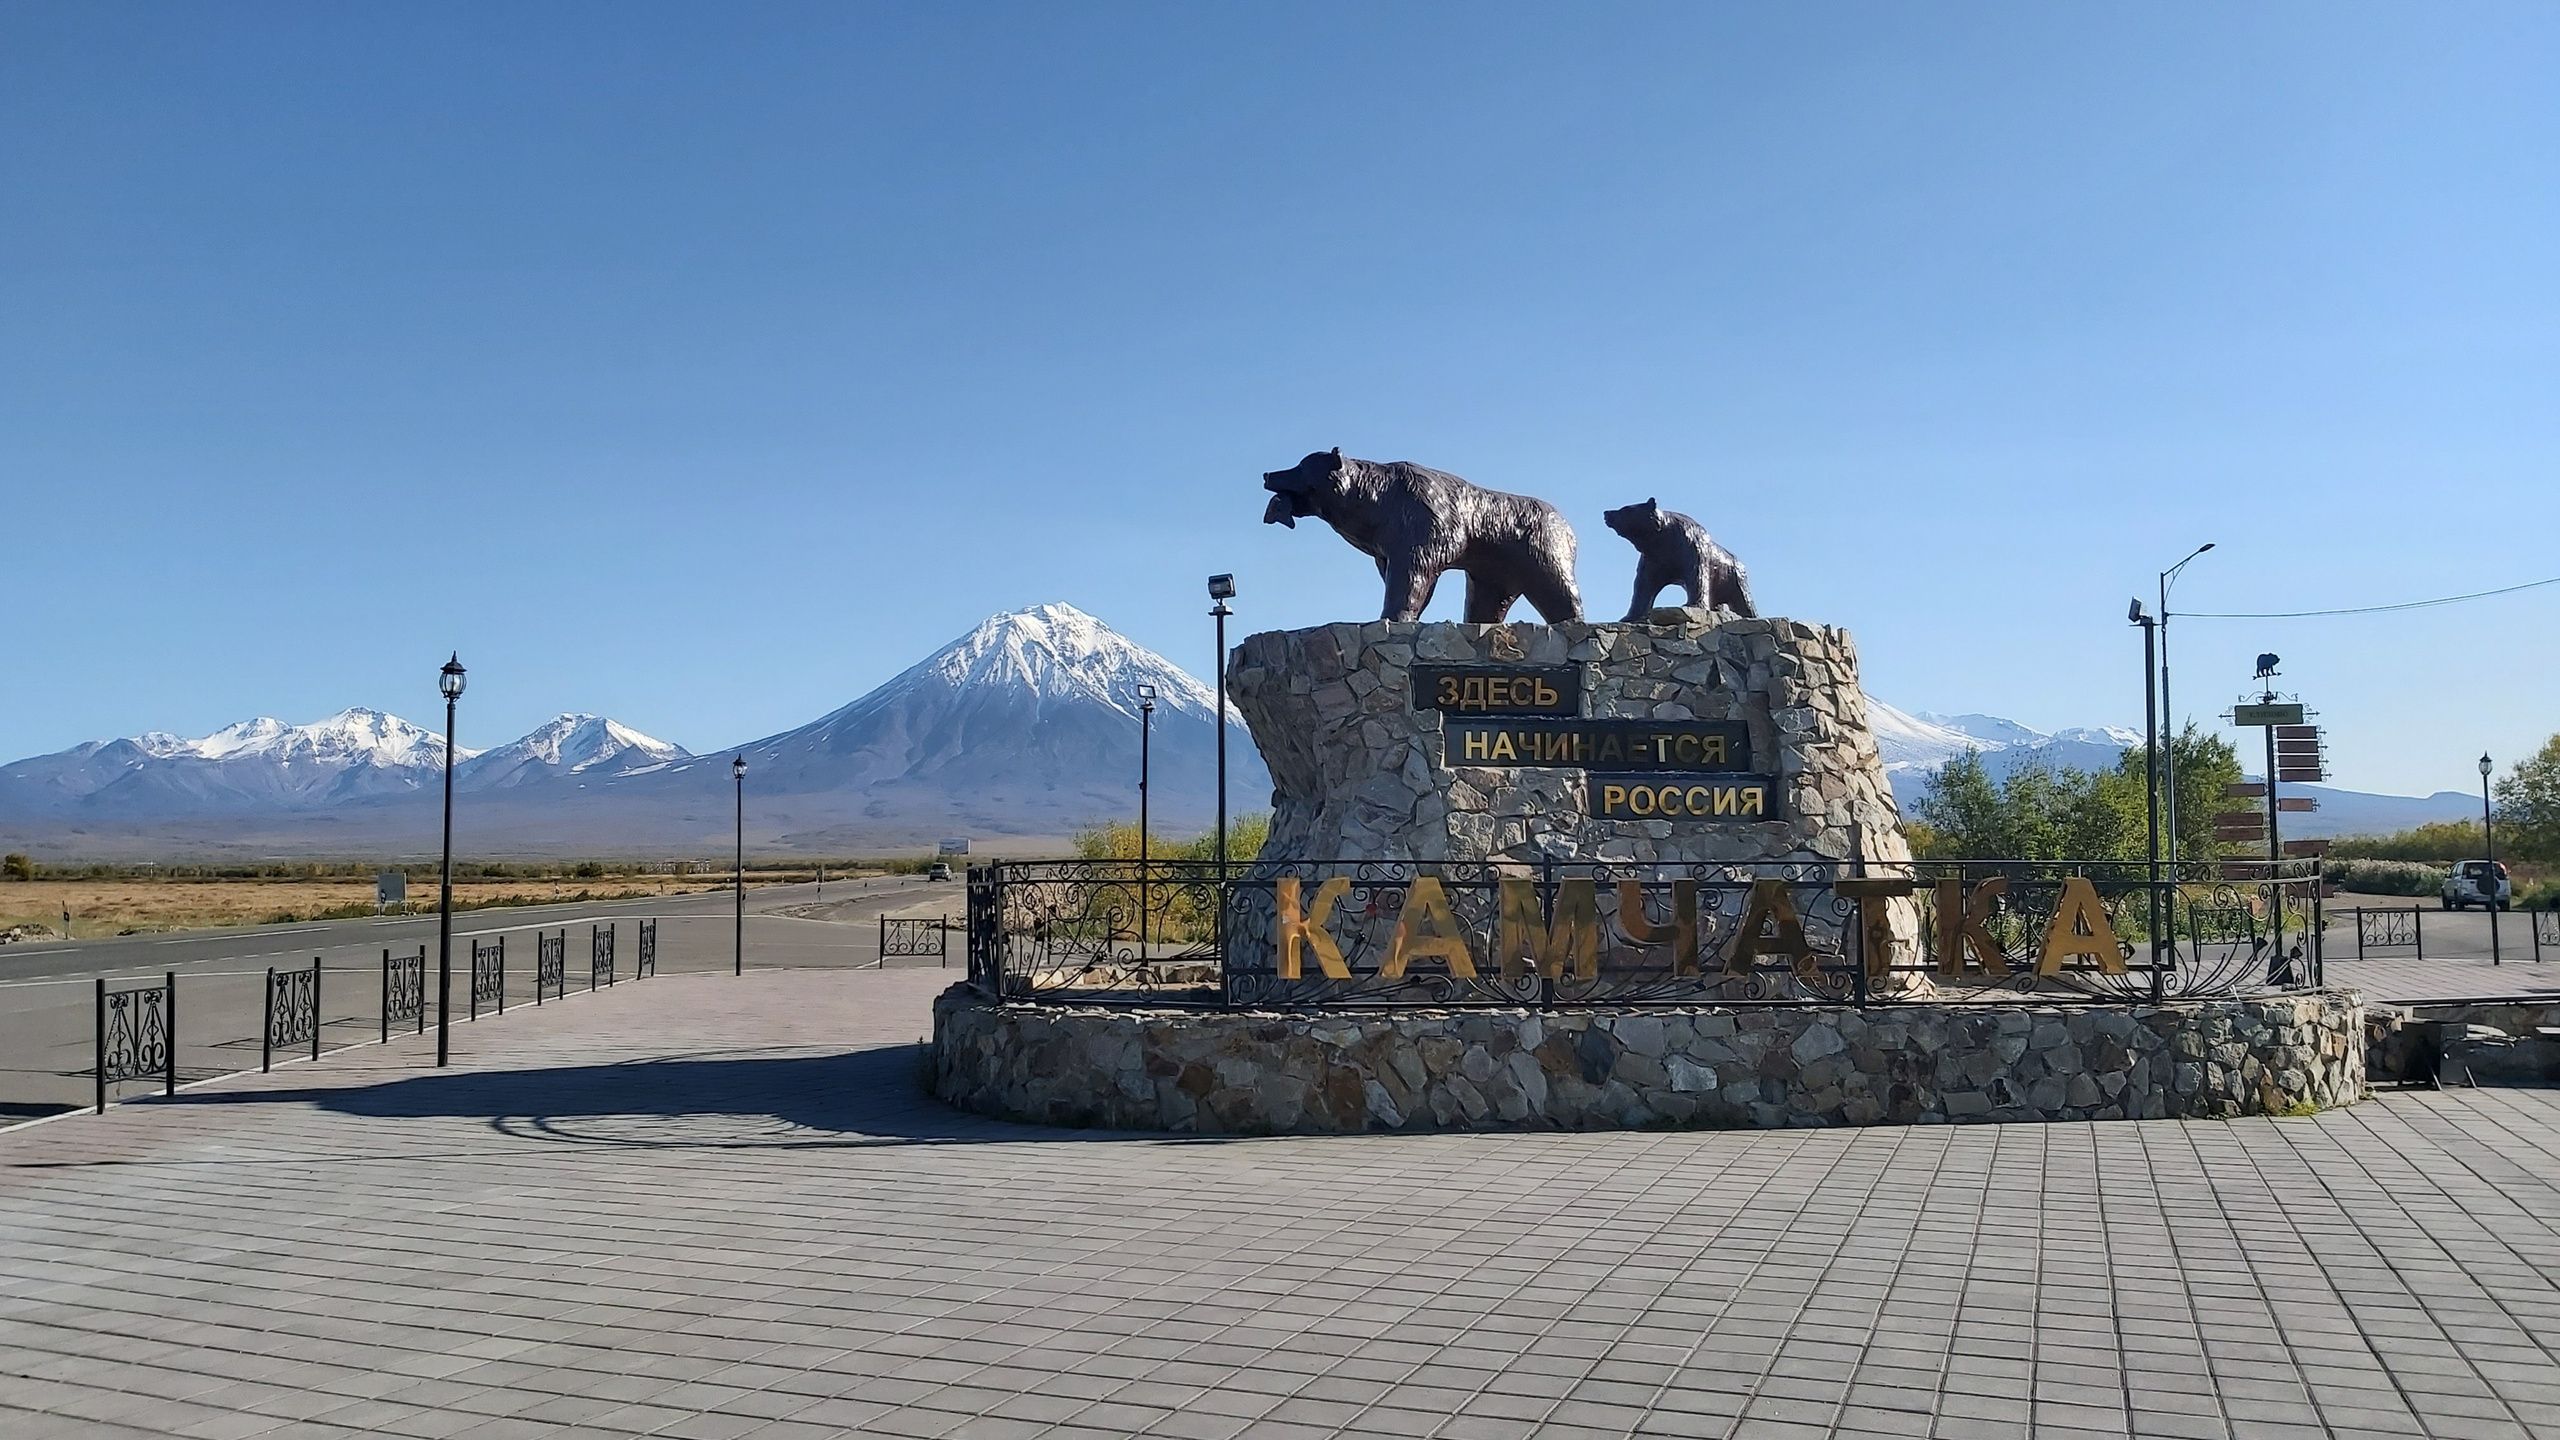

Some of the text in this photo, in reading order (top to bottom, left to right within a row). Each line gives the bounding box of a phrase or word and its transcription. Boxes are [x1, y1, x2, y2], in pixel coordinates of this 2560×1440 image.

[1437, 676, 1559, 711] ЗДЕСЬ
[1464, 731, 1726, 764] НАЧИНАЕТСЯ
[1603, 785, 1764, 816] РОССИЯ
[1276, 876, 2129, 981] КАМЧАТКА
